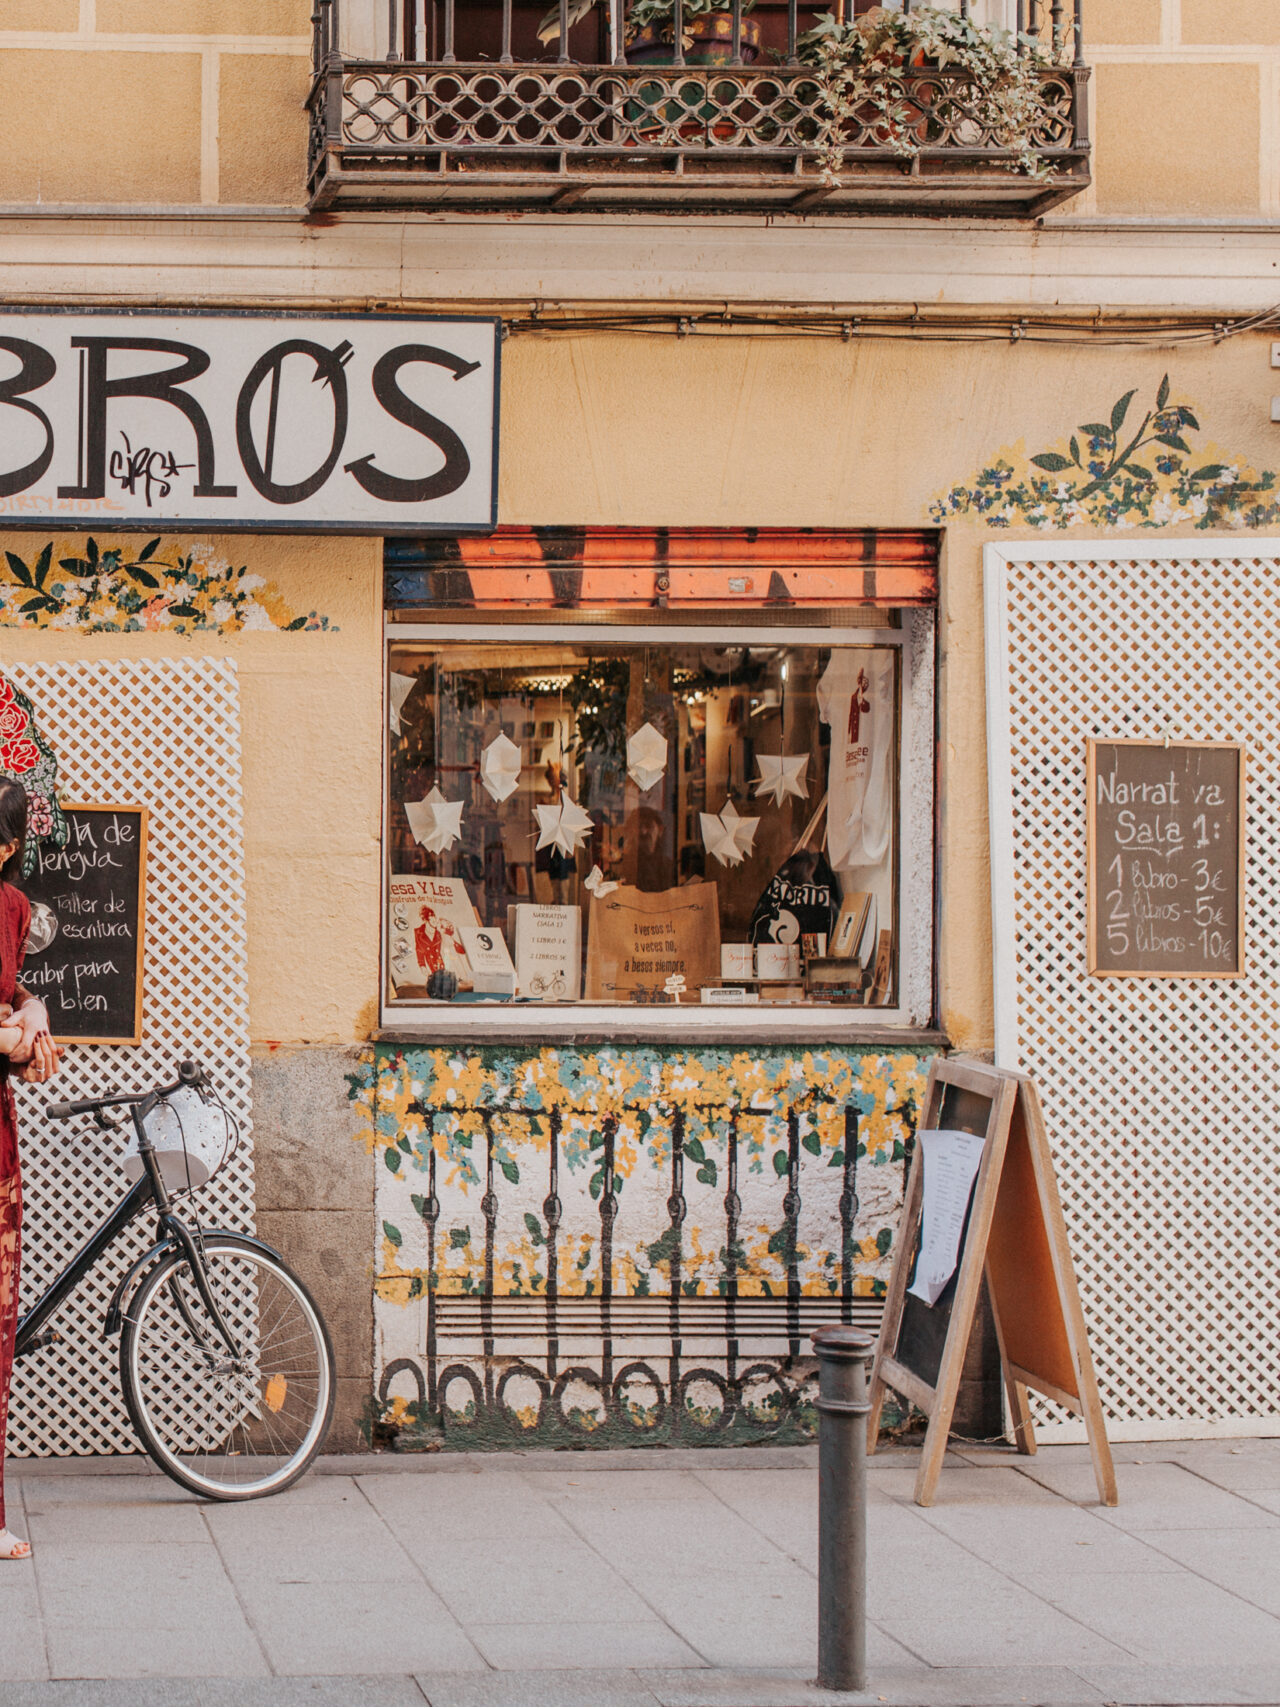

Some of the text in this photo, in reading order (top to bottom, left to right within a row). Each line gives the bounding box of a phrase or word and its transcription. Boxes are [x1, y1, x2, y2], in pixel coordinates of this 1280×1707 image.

[103, 814, 135, 846] de
[1114, 810, 1185, 844] Sala
[37, 845, 123, 880] lengua
[1108, 854, 1123, 887] 1
[53, 889, 127, 917] Taller de
[390, 881, 454, 897] esa Y Lee
[532, 912, 567, 920] NARRATIVA
[1106, 889, 1130, 920] 2
[62, 919, 133, 938] escritura
[639, 924, 664, 936] versos
[1106, 922, 1129, 955] 5
[635, 942, 639, 952] a
[640, 941, 663, 952] veces
[16, 960, 119, 989] scribir para
[624, 960, 629, 972] a
[631, 956, 653, 973] besos
[60, 989, 108, 1012] bien
